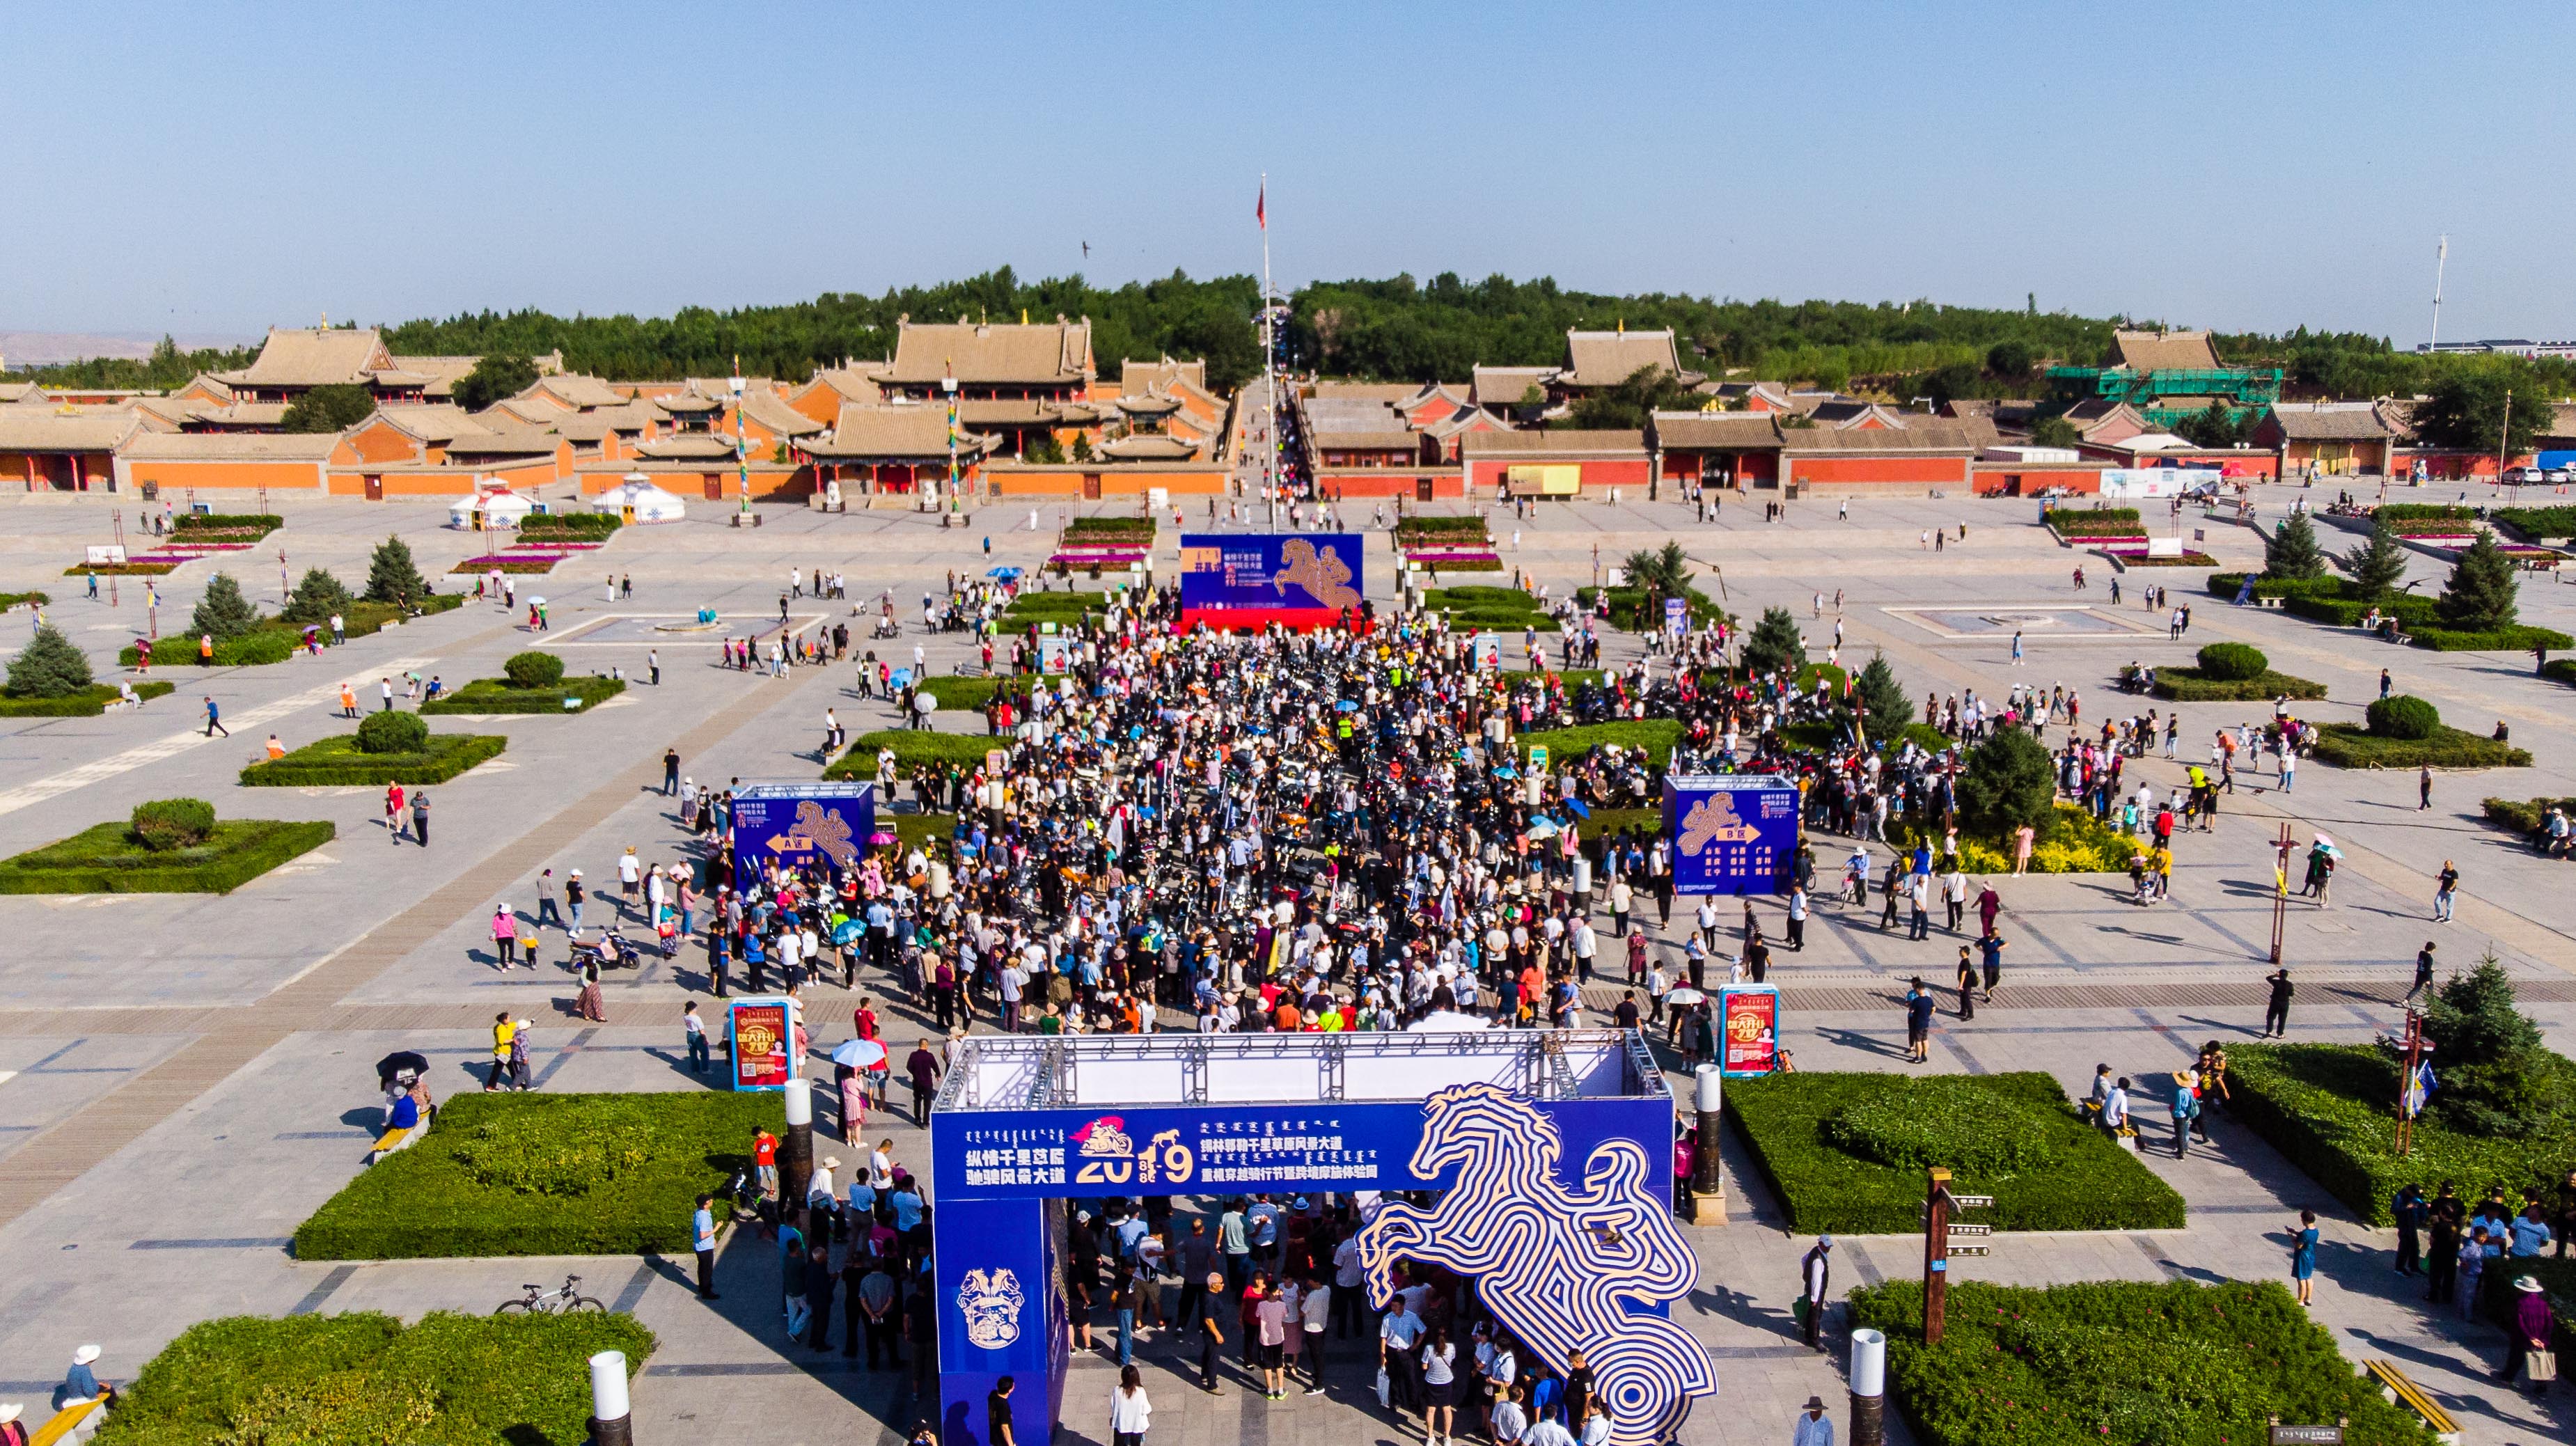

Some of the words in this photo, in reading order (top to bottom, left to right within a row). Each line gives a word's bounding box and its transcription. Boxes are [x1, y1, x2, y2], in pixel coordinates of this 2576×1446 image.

[1200, 1135, 1343, 1153] 锡林郭勒千里草原风景大道
[966, 1148, 1065, 1167] 纵情千里草原
[966, 1167, 1066, 1186] 驰骋风景大道
